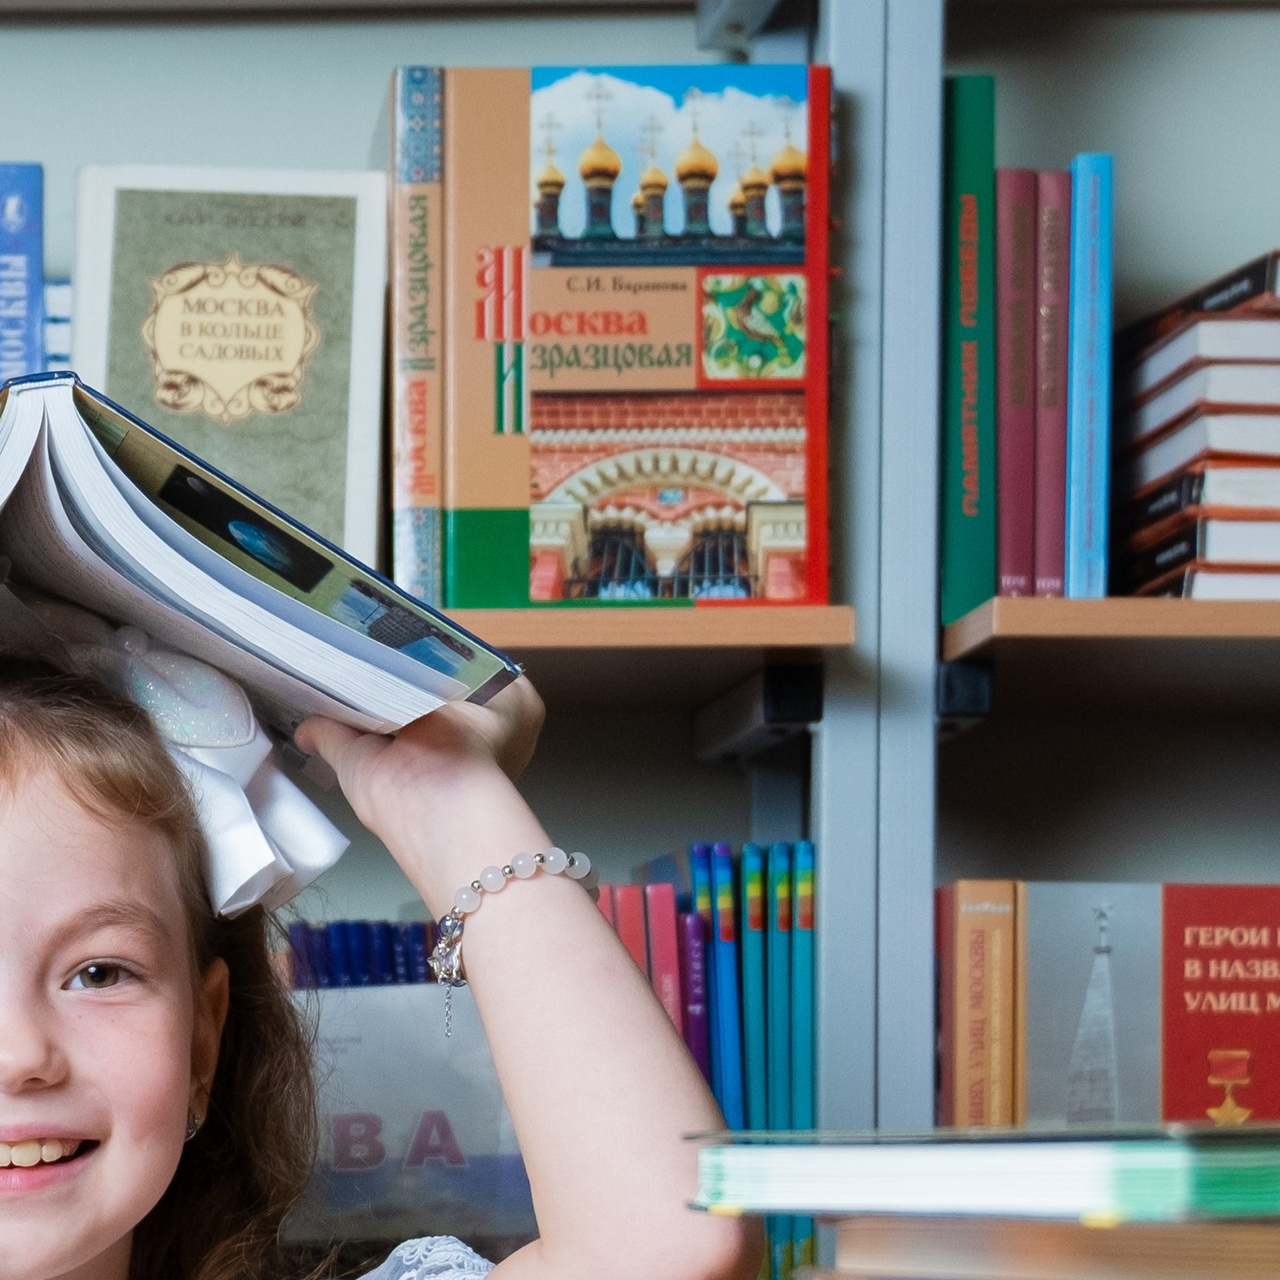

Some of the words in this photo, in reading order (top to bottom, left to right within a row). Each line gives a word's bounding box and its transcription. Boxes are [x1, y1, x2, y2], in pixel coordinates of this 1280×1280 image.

[959, 194, 979, 327] ПОБЕДЫ
[612, 276, 688, 294] Баранова
[182, 298, 285, 317] МОСКВА
[180, 321, 192, 337] В
[198, 321, 284, 340] КОЛЬЦЕ
[179, 342, 284, 361] САДОВЫХ
[960, 341, 979, 516] ПАМЯТНИК
[1183, 926, 1269, 947] ГЕРОИ
[690, 938, 704, 994] класс
[968, 930, 986, 1010] МОСКВЫ
[1184, 959, 1202, 979] В
[1208, 959, 1280, 980] НАЗВ
[688, 1004, 704, 1015] 4
[1183, 991, 1260, 1015] УЛИЦ
[331, 1109, 470, 1173] ВА
